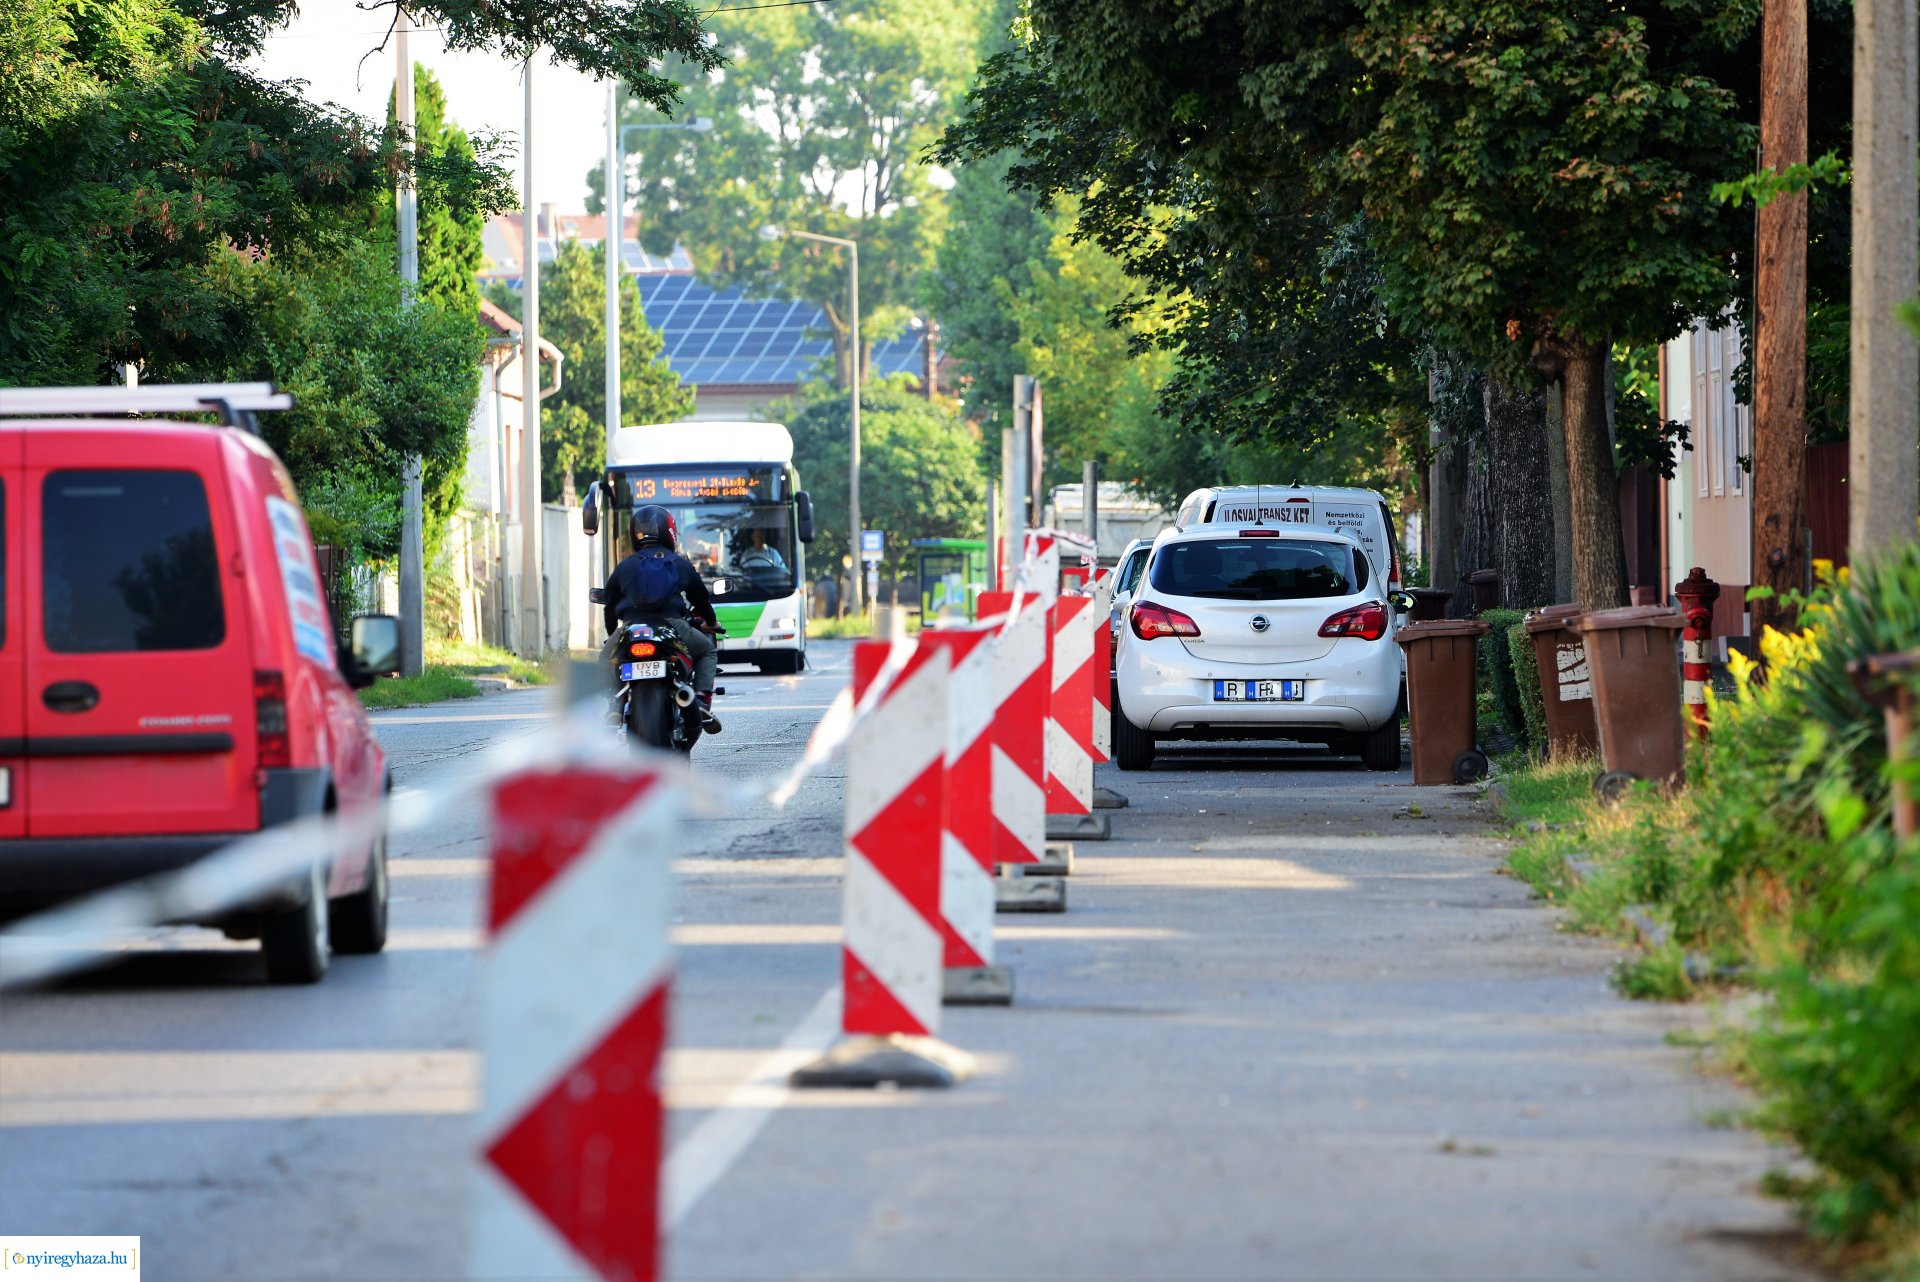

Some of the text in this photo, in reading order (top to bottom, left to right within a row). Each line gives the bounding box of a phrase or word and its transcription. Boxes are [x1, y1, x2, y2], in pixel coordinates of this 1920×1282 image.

[635, 480, 656, 498] 13
[1258, 508, 1291, 522] TRANSZ
[1325, 511, 1365, 519] Nemzetközi
[636, 661, 661, 670] UVB
[639, 669, 659, 677] 150
